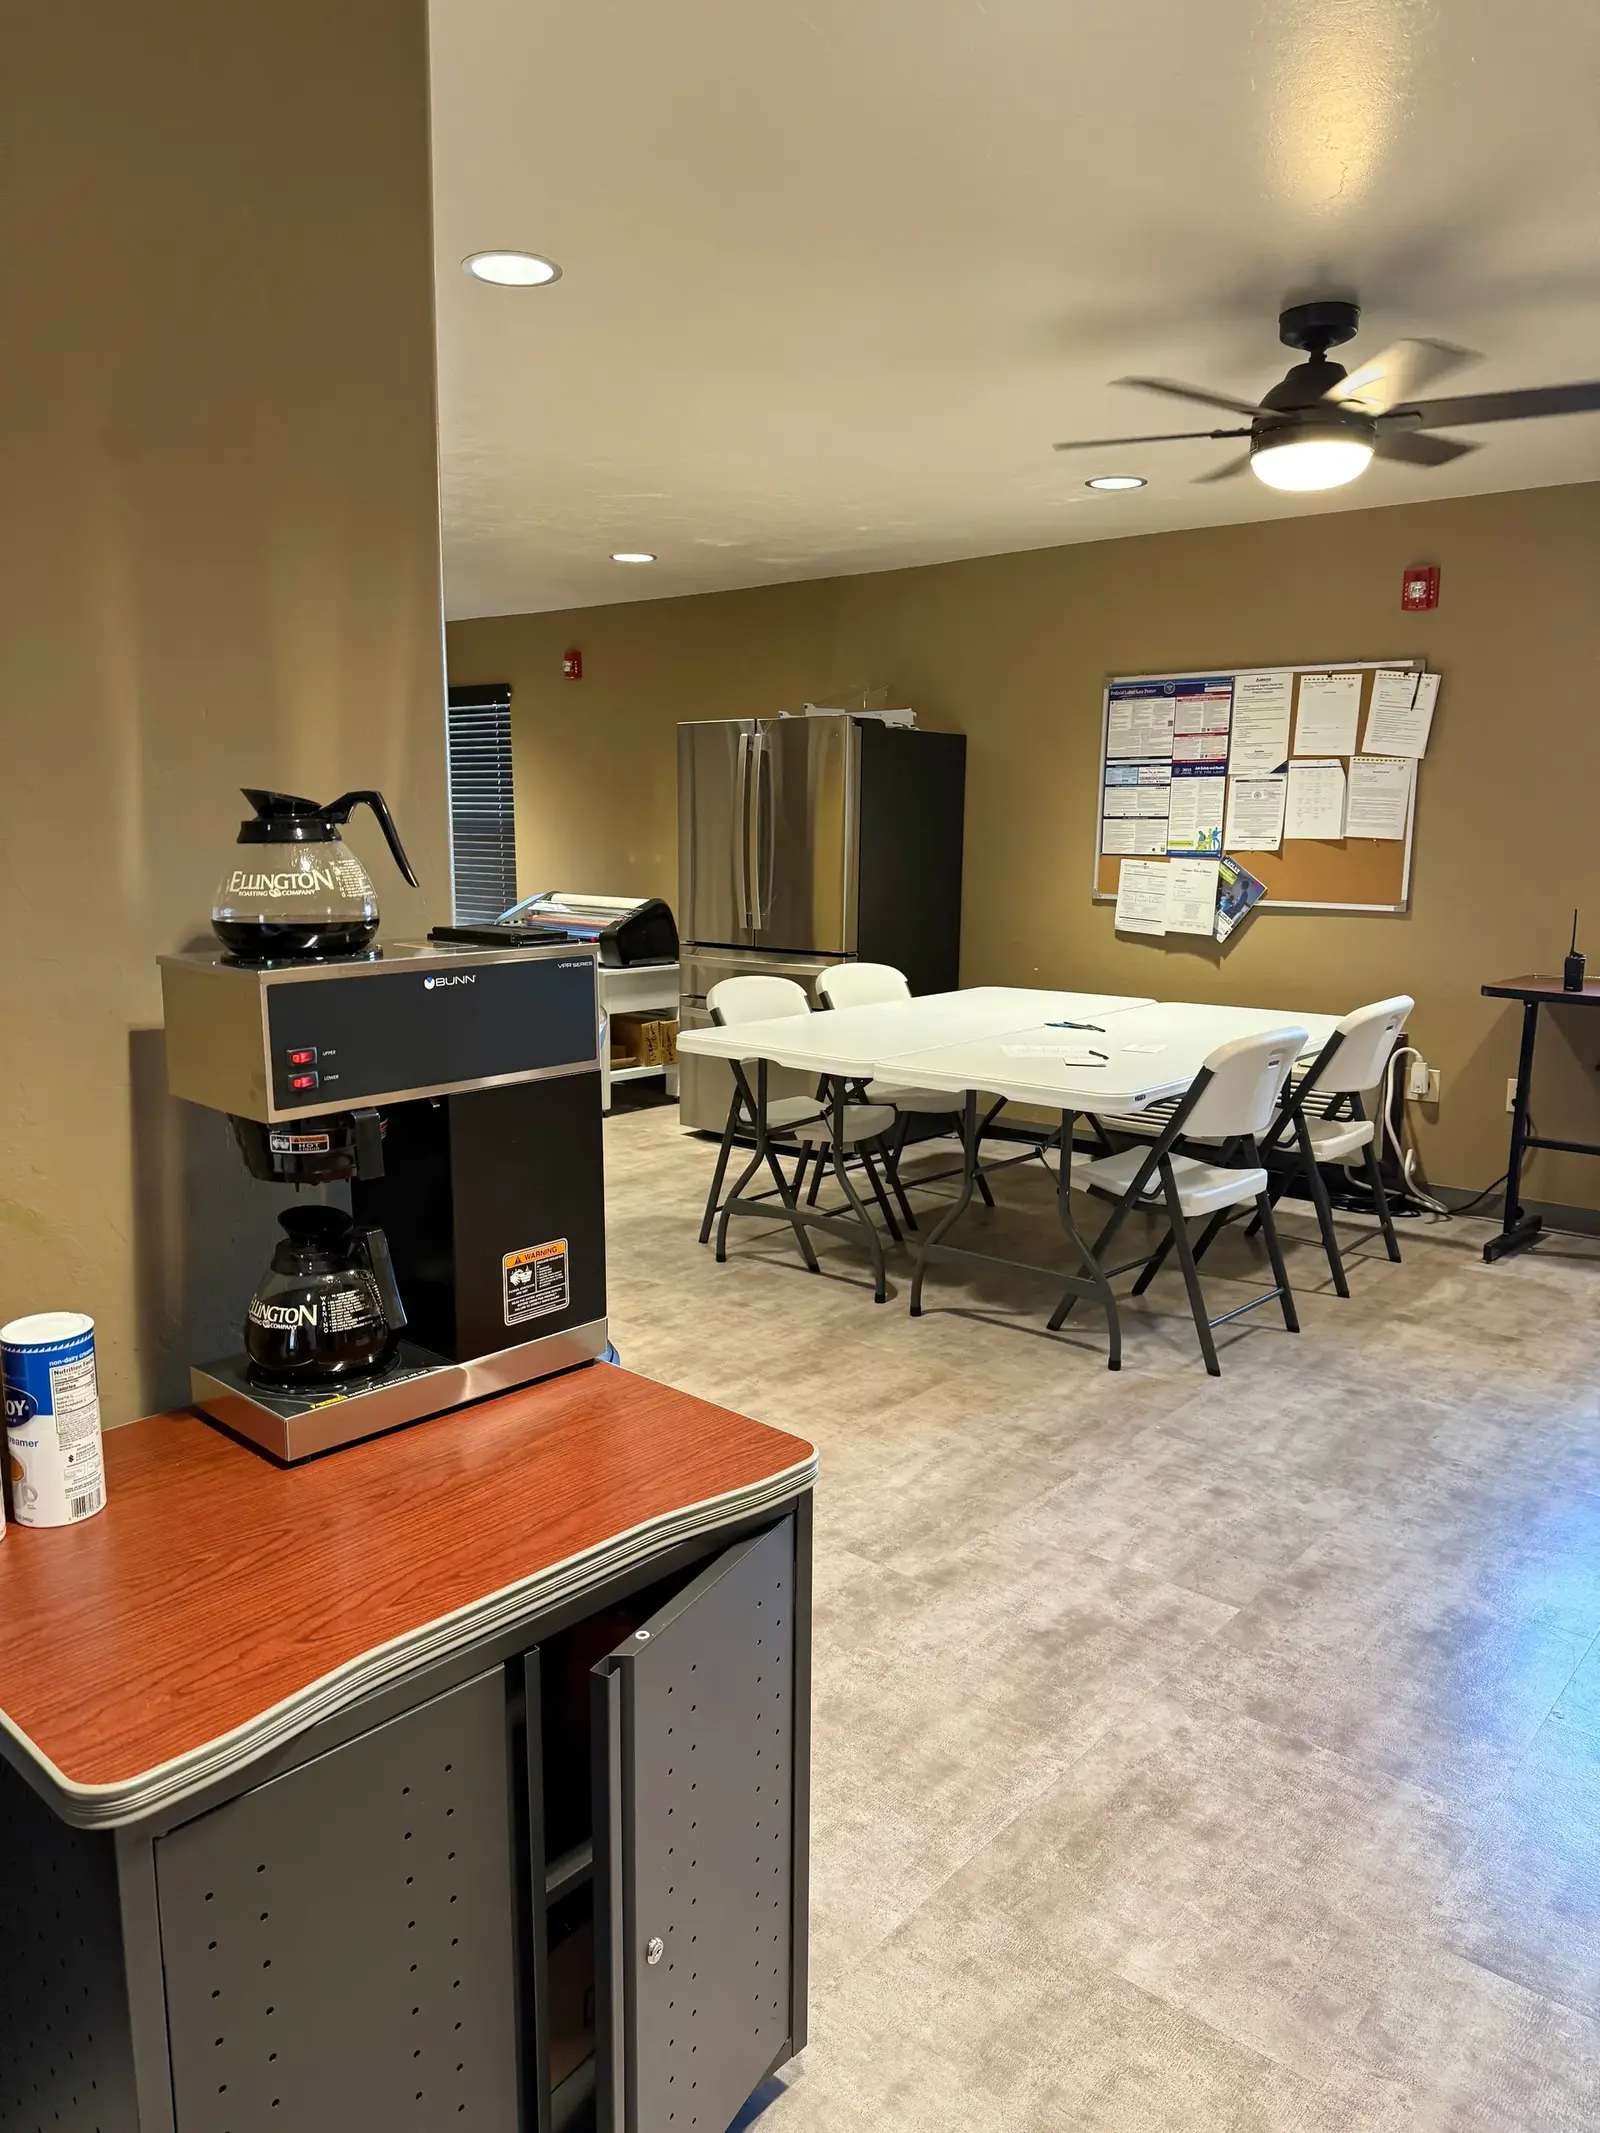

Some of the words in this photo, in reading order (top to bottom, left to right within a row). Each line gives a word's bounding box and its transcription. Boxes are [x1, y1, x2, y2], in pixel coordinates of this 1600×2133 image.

[229, 869, 334, 892] ELLINGTON
[238, 889, 268, 897] ROASTING
[281, 889, 316, 897] COMPANY
[435, 975, 476, 987] BUNN
[524, 1245, 557, 1260] WARNING
[320, 1296, 329, 1333] WARNING
[48, 1354, 78, 1366] non-dairy
[54, 1364, 82, 1375] Nutrition
[5, 1400, 26, 1416] OY
